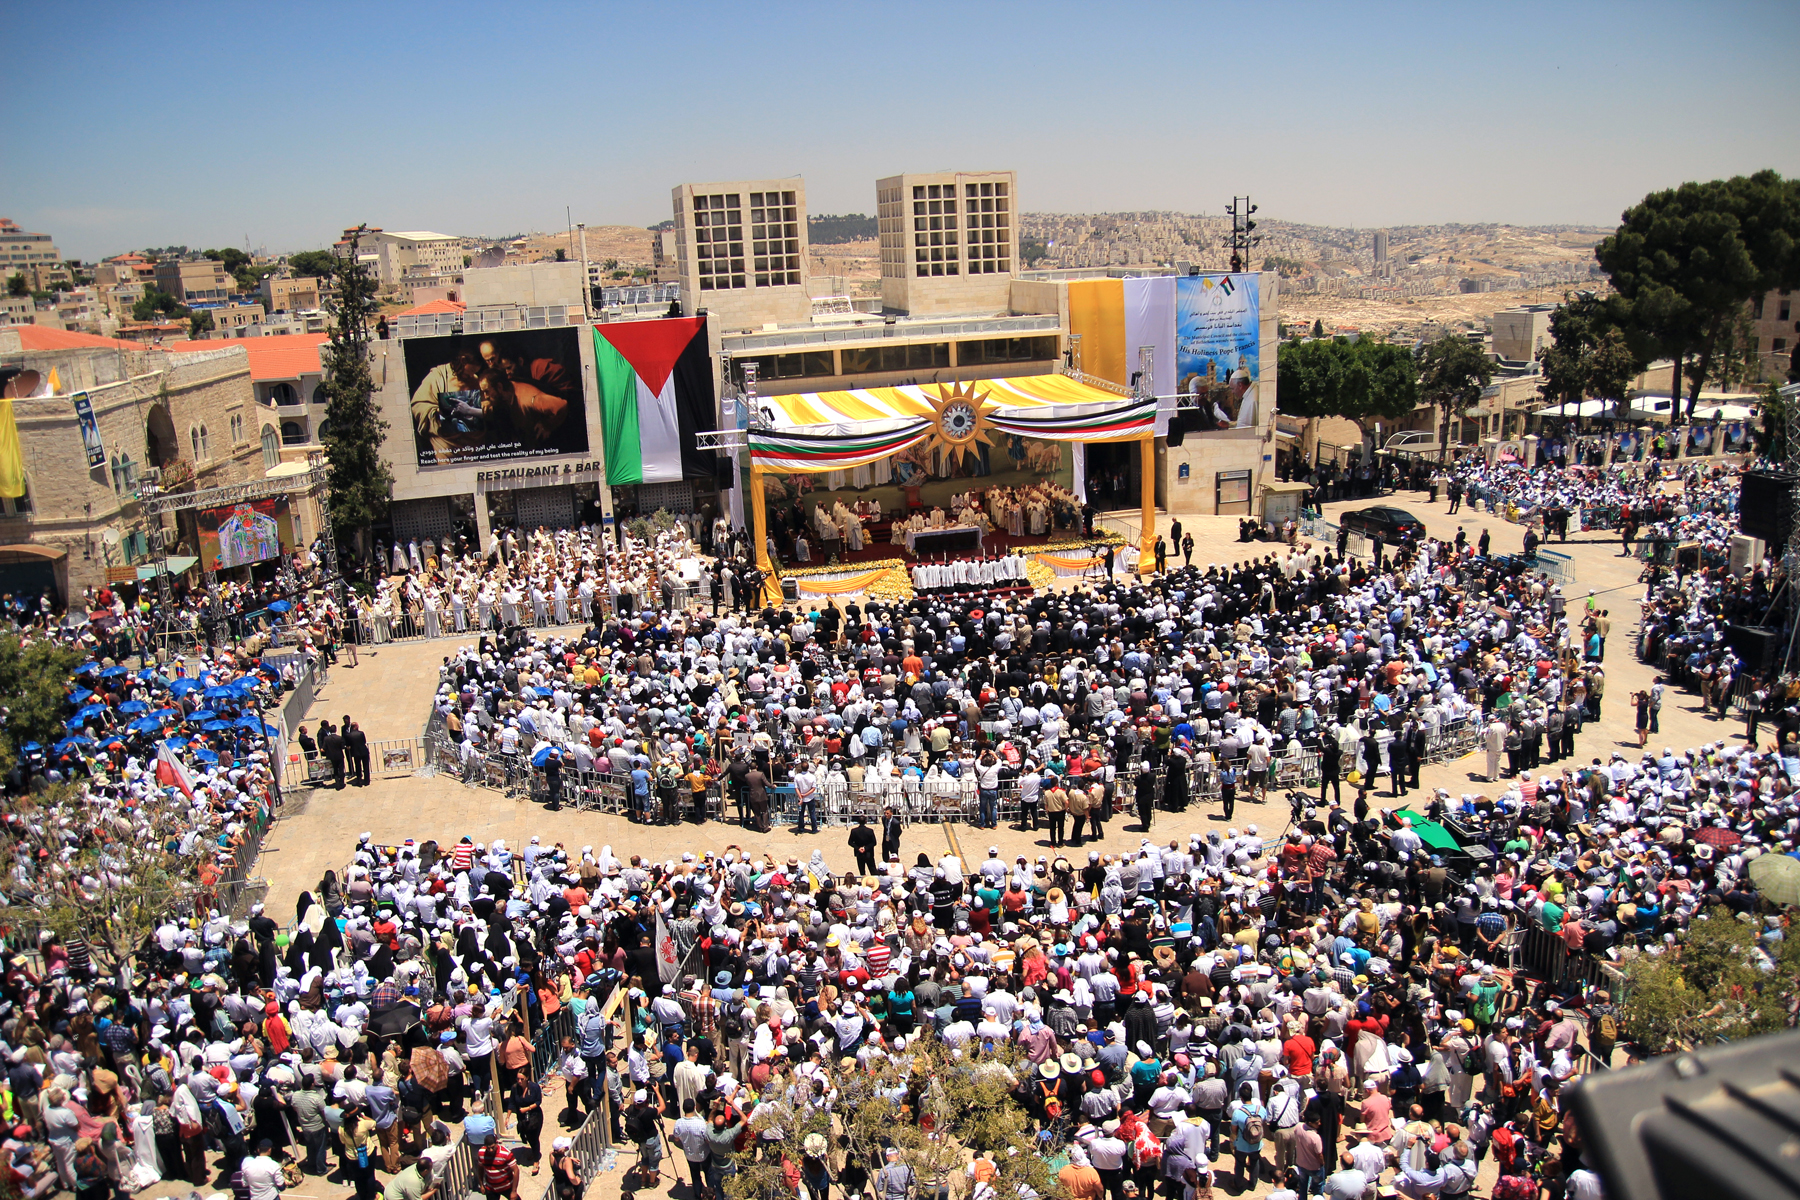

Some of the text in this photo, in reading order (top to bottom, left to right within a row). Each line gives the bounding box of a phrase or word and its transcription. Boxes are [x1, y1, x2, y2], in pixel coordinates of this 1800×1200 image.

[1180, 341, 1256, 356] His Holiness Pope Francis
[476, 461, 600, 482] RESTAURANT & BAR
